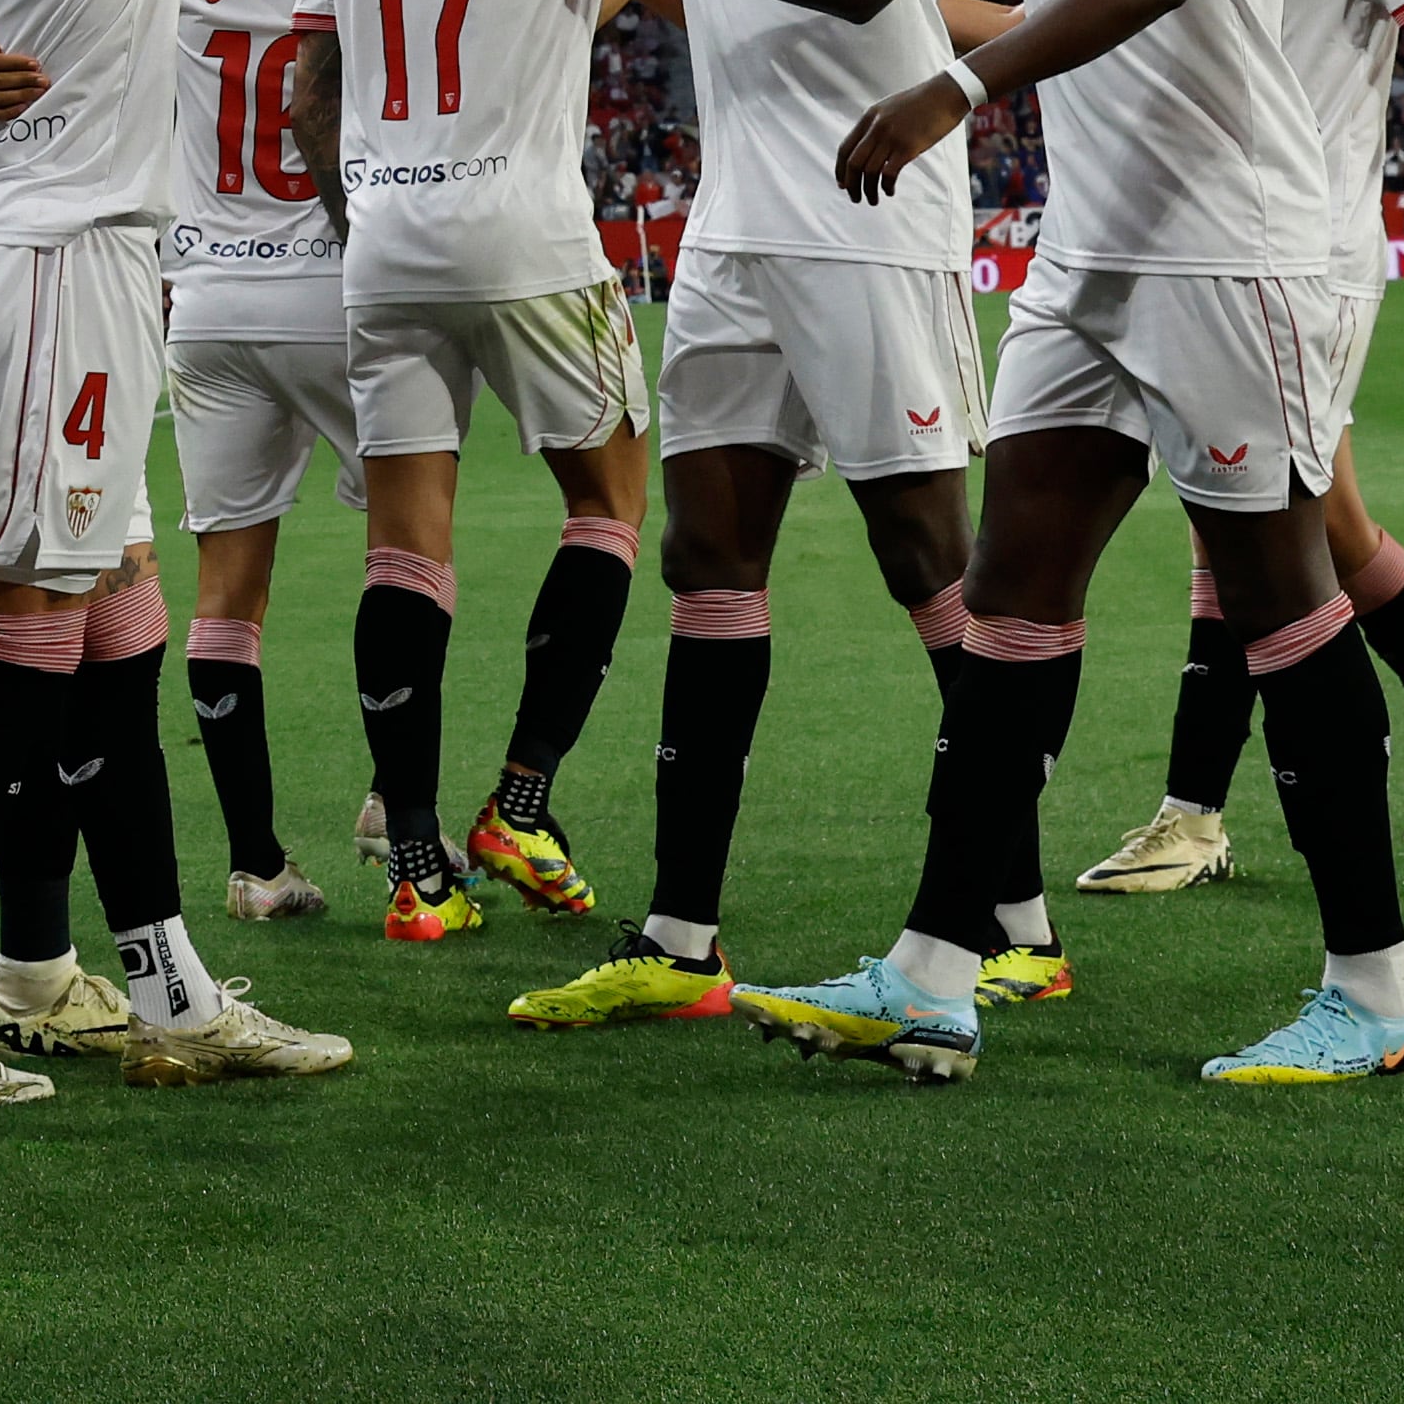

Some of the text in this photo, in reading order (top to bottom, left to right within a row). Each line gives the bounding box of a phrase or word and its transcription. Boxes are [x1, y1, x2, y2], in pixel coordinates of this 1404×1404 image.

[368, 153, 507, 187] socios.com
[63, 372, 108, 460] 4
[152, 919, 178, 984] TAPEDESIG
